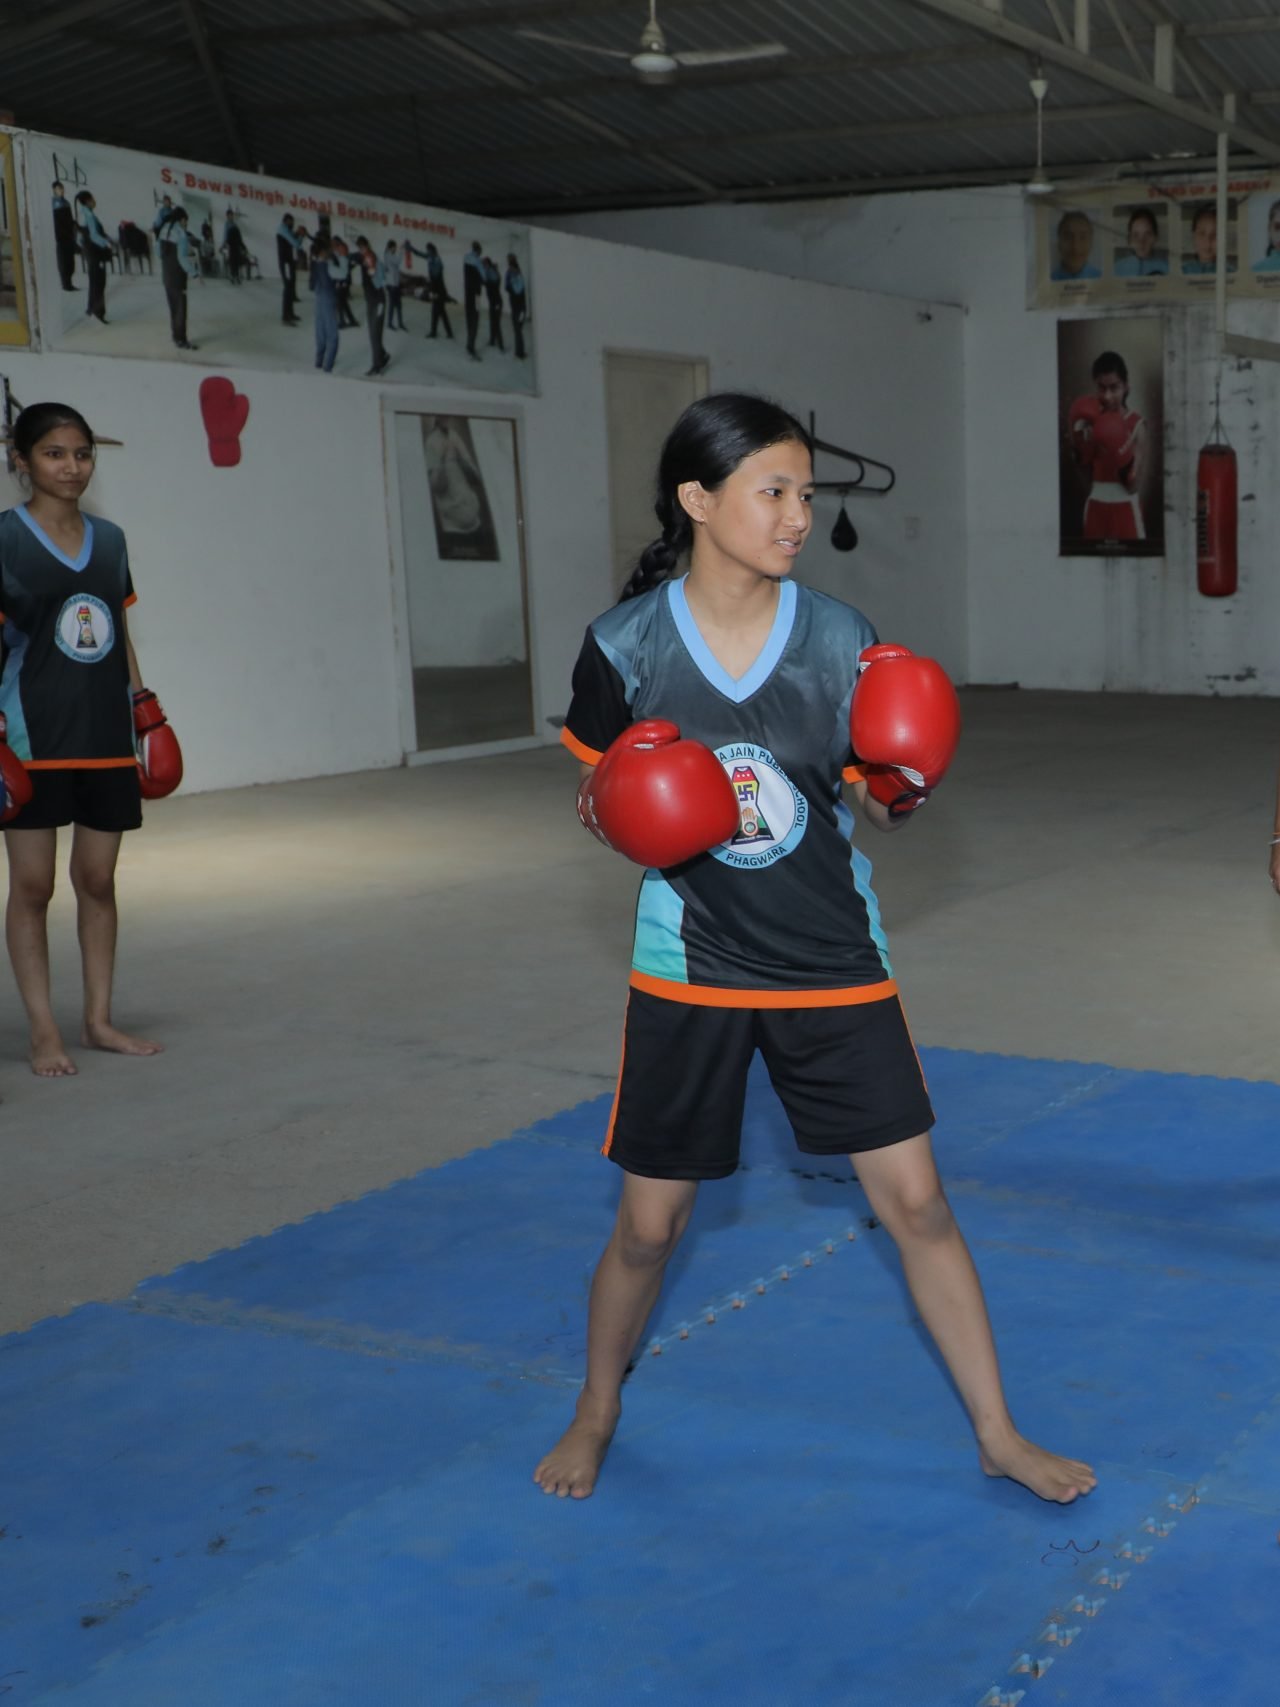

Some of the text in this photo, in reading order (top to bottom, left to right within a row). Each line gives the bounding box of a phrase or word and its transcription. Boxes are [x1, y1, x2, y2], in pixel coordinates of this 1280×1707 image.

[161, 168, 456, 239] S. Bawa Singh Johal Boxing Academy
[730, 746, 755, 758] JAIN
[726, 845, 787, 867] PHAGWARA
